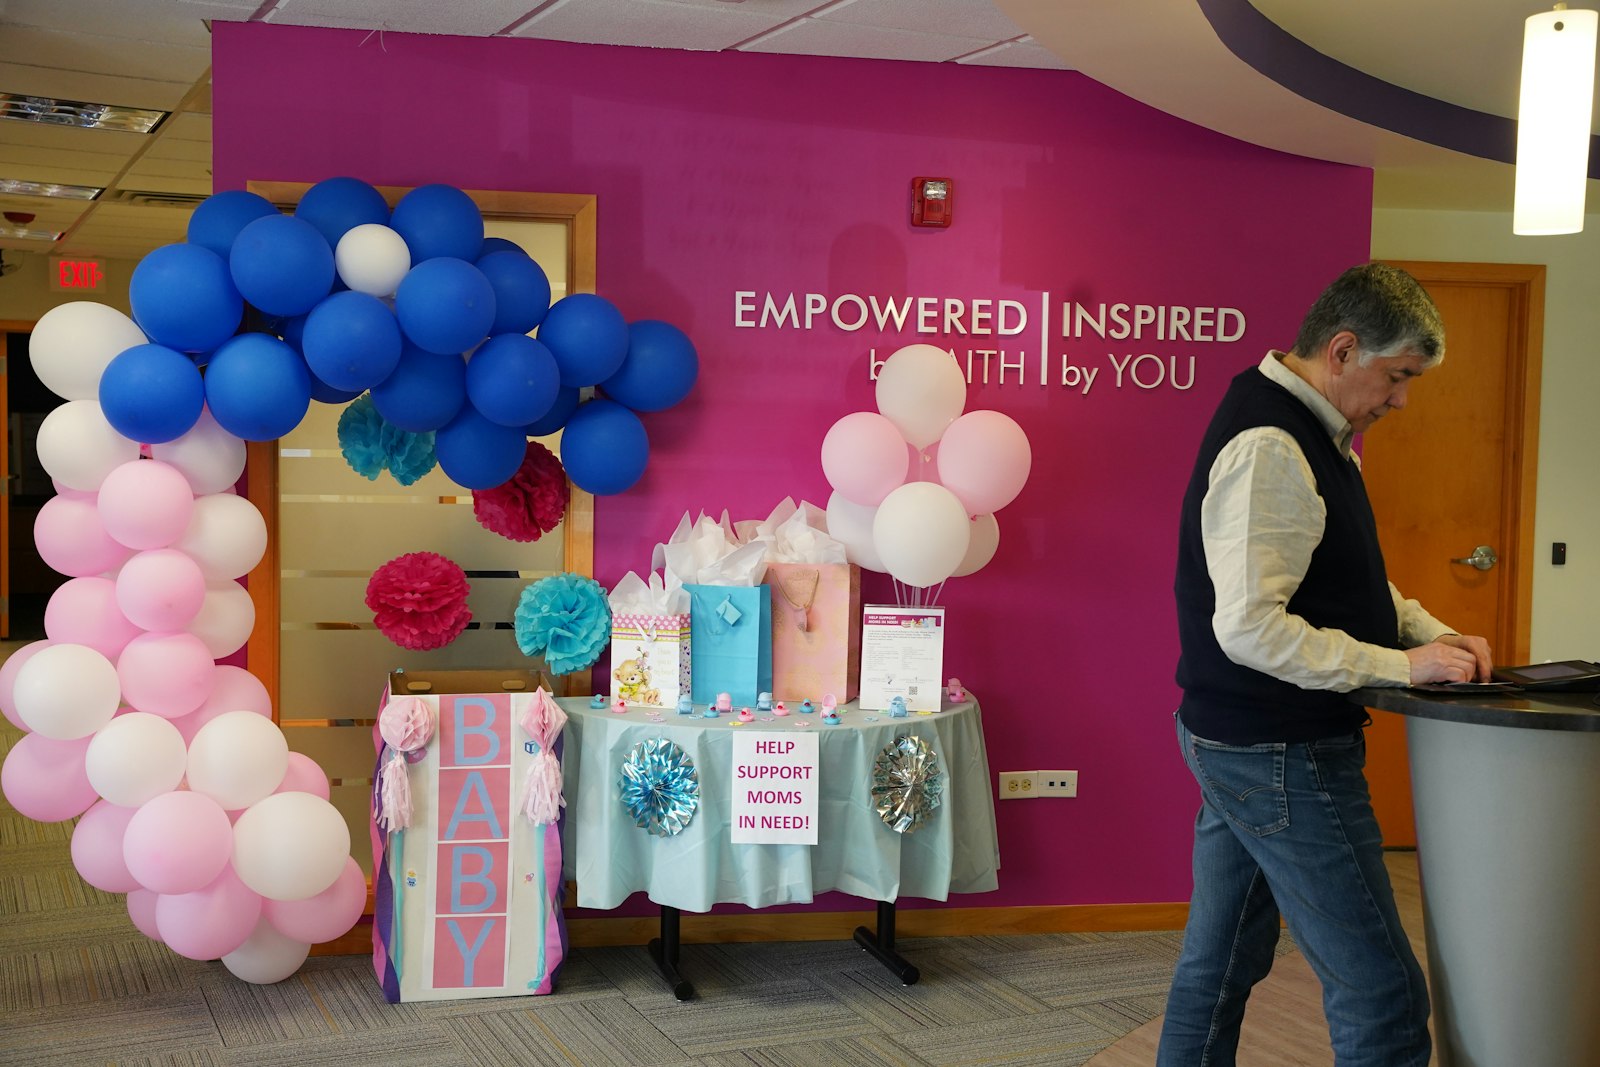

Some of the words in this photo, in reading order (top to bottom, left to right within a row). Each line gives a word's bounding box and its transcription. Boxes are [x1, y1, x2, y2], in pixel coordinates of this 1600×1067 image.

[59, 261, 97, 288] EXIT
[735, 290, 1028, 336] EMPOWERED
[1062, 302, 1246, 342] INSPIRED
[1062, 354, 1099, 395] by
[1108, 353, 1196, 390] YOU
[756, 741, 795, 754] HELP
[737, 765, 812, 779] SUPPORT
[747, 790, 802, 805] MOMS
[739, 815, 755, 829] IN
[761, 815, 809, 829] NEED!
[444, 697, 503, 987] BABY
